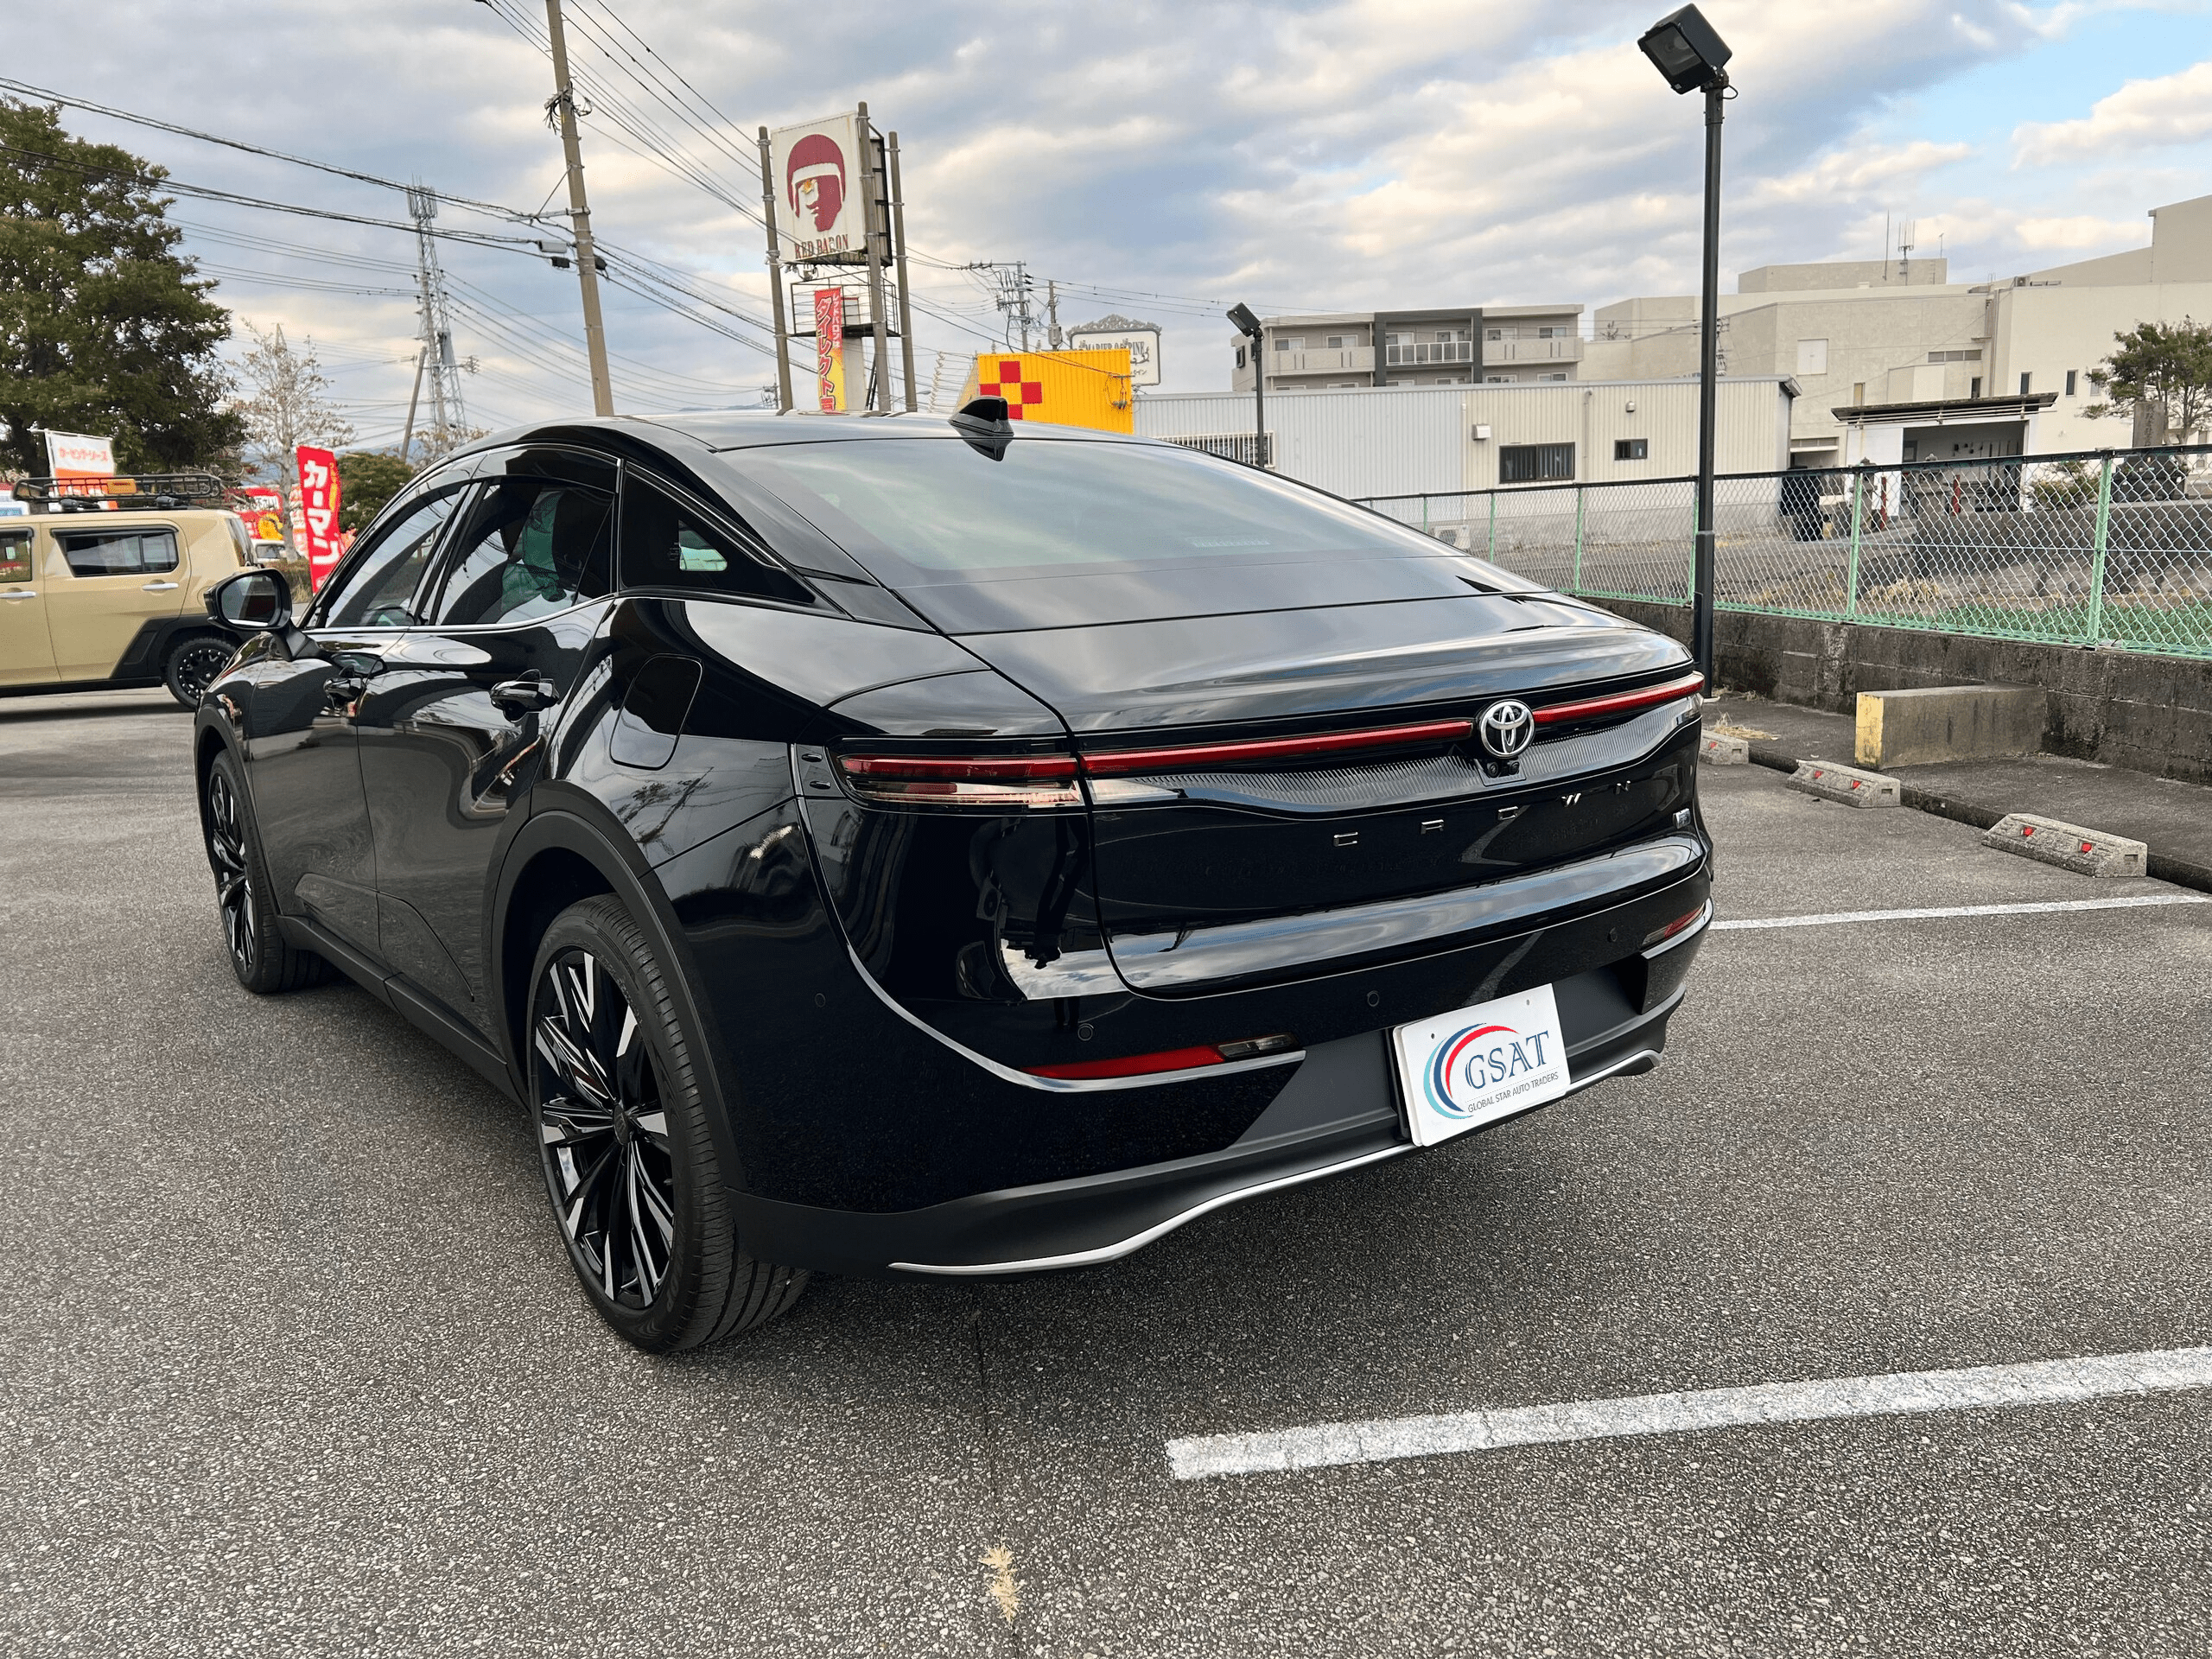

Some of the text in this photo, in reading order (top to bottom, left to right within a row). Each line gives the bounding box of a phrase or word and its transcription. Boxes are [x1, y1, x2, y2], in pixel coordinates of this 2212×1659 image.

[794, 234, 849, 258] RED BARON
[303, 460, 340, 564] カーマン
[1465, 1030, 1549, 1090] GSAT
[1468, 1071, 1559, 1113] GLOBAL STAR AUTO TRADERS
